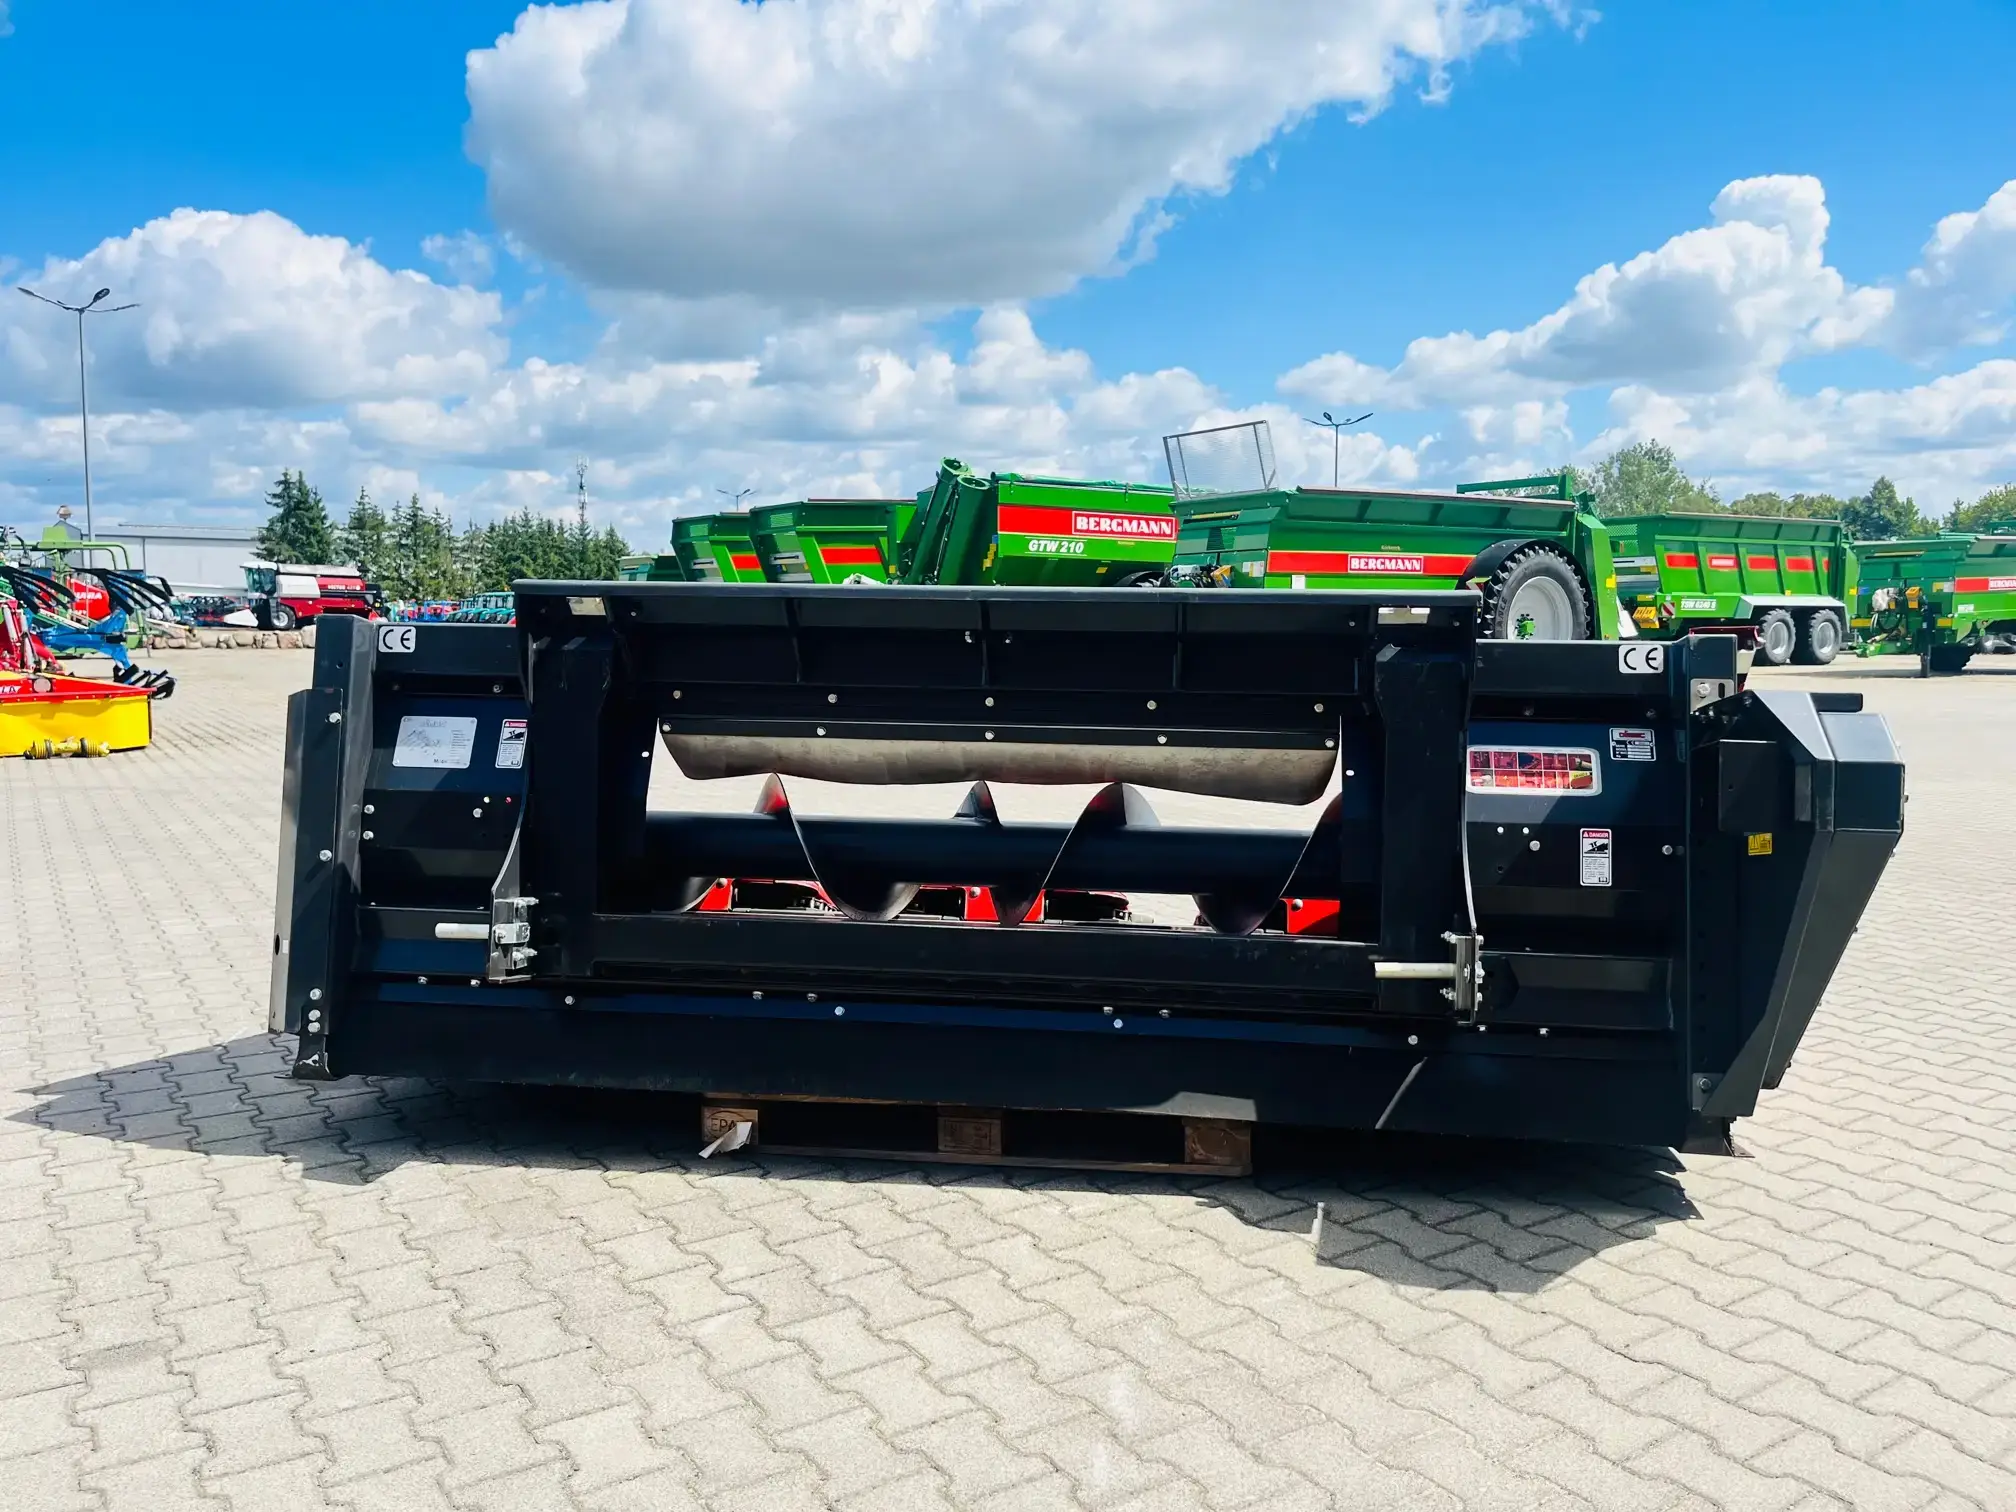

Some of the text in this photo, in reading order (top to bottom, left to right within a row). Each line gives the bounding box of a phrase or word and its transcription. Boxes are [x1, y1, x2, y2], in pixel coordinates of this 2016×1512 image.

[1076, 515, 1171, 534] BERGMANN
[1029, 540, 1084, 553] GTW 210
[1350, 557, 1421, 570] BERGMANN
[383, 629, 412, 650] CE
[1624, 647, 1658, 670] CE
